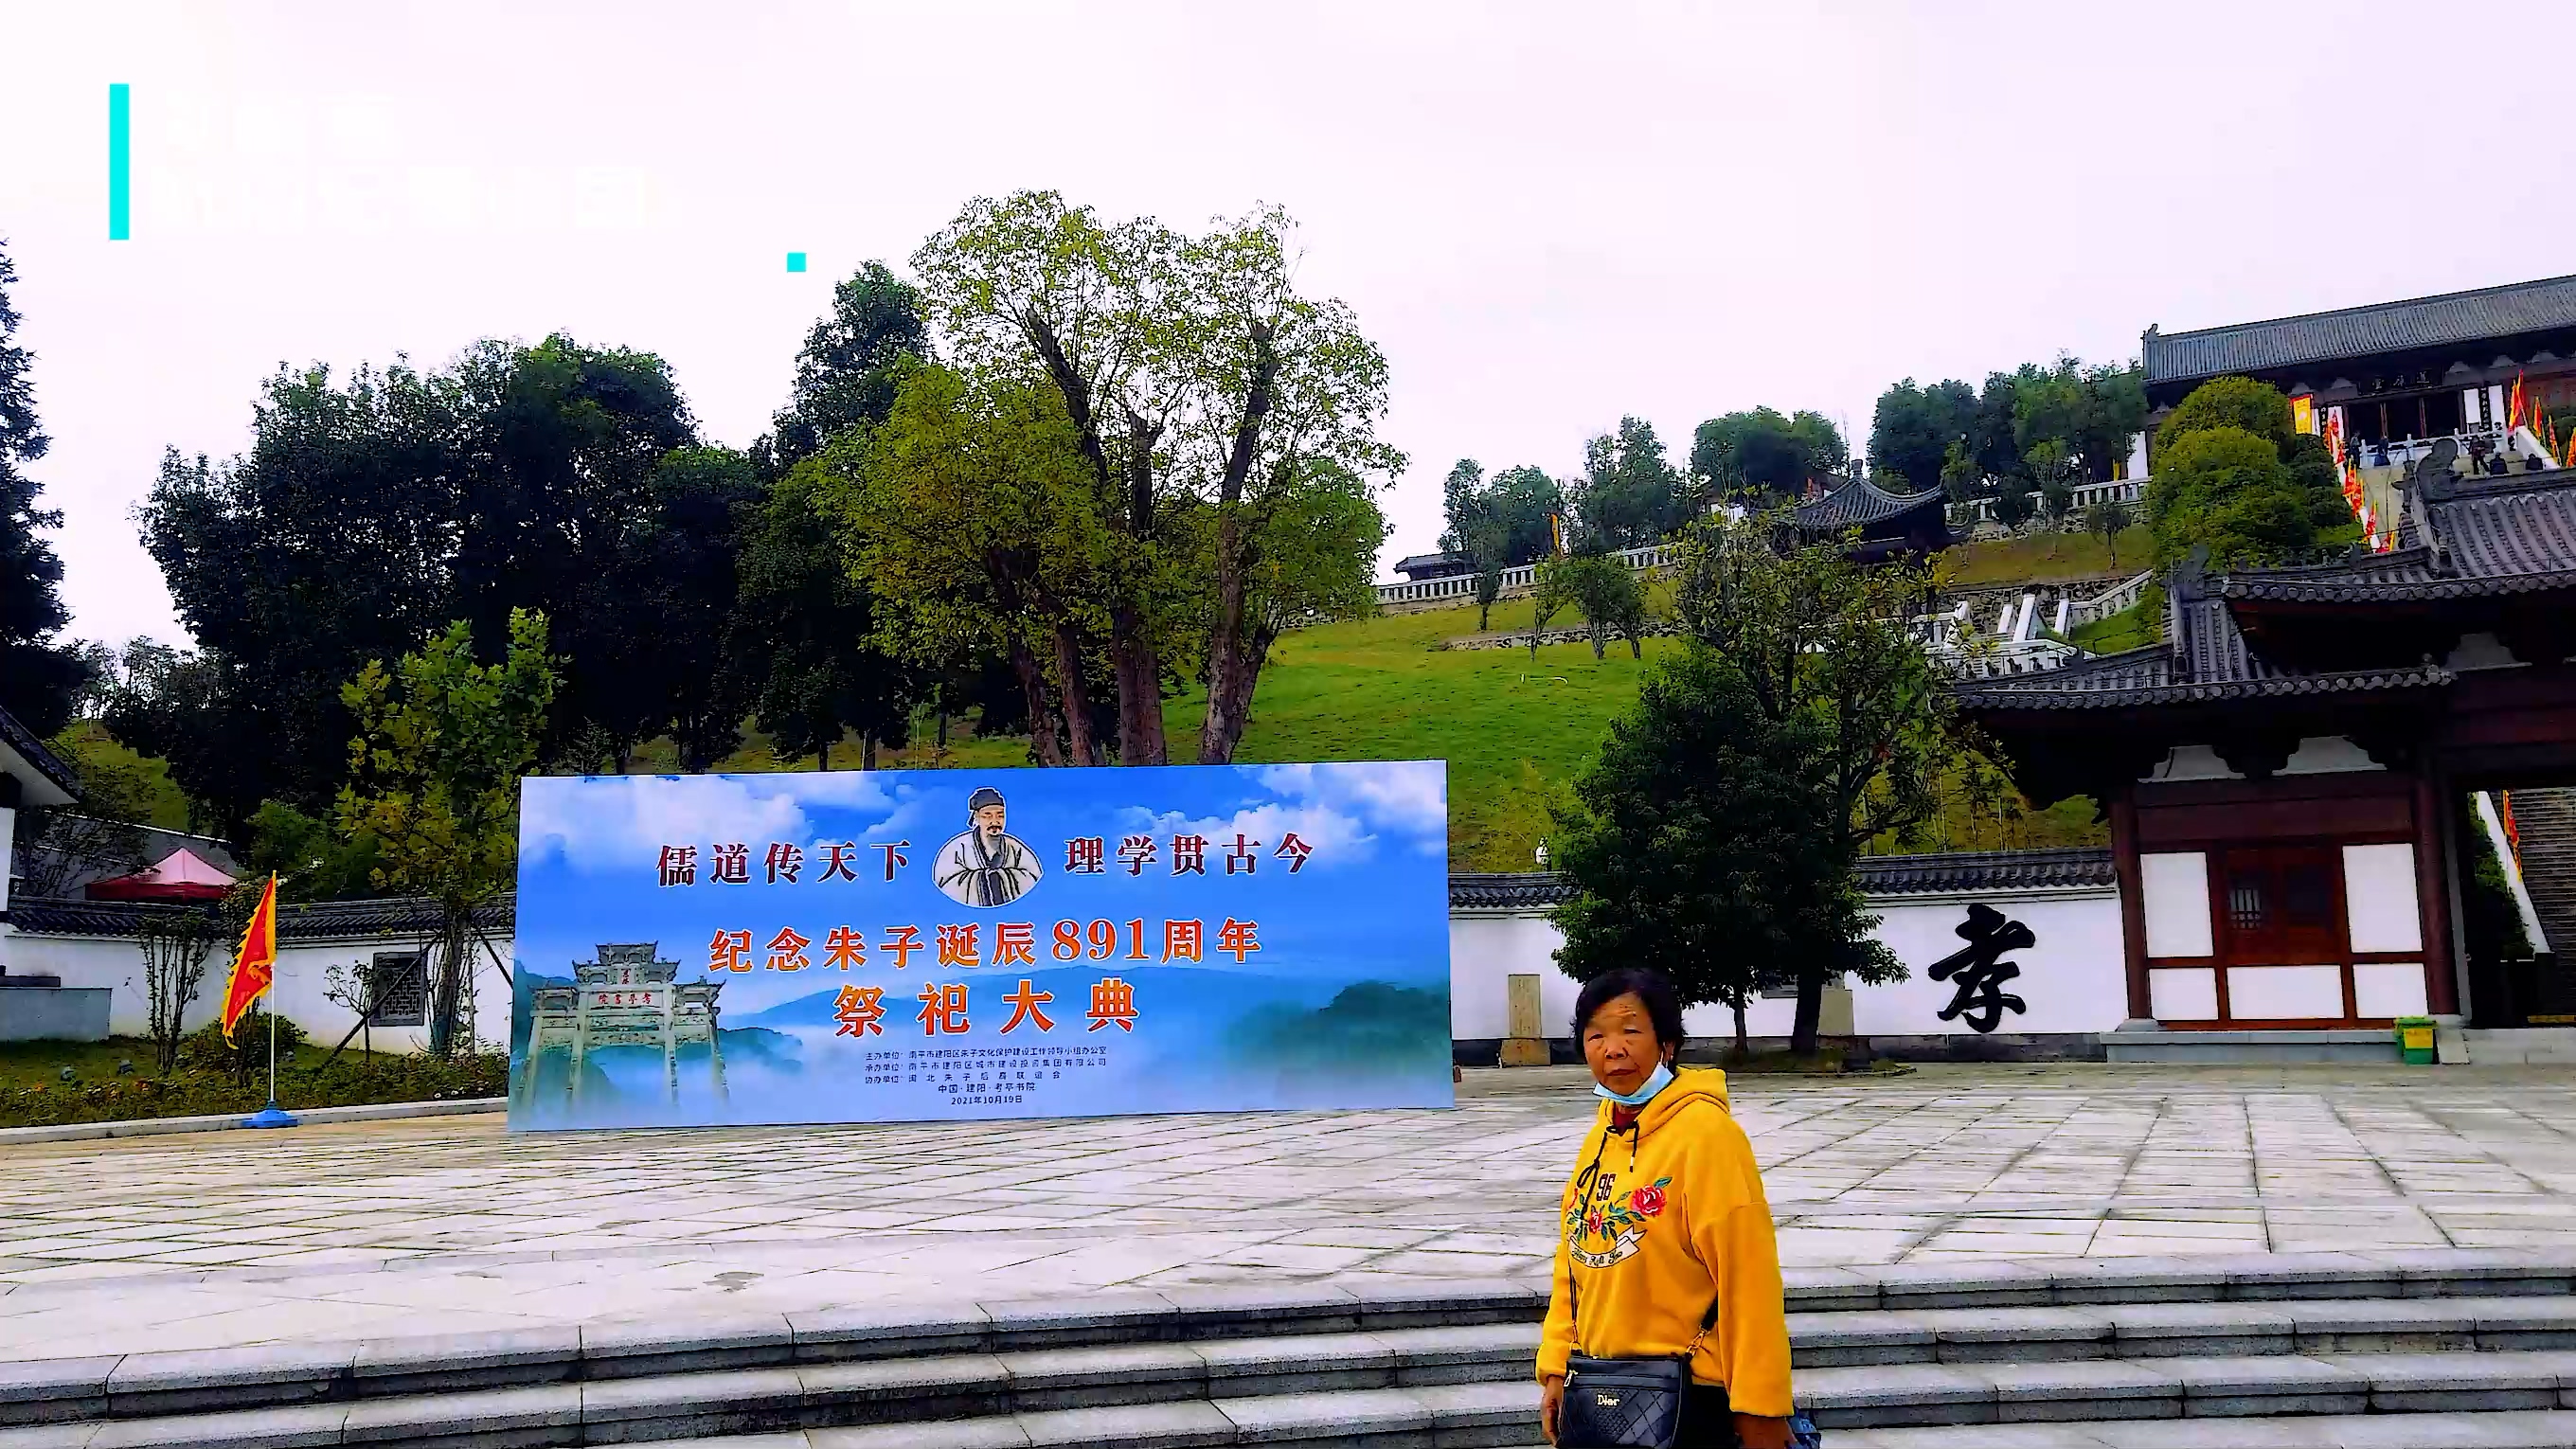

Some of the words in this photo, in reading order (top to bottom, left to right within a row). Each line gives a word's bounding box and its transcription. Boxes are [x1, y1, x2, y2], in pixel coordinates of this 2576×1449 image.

[655, 839, 912, 887] 儒道传天下
[1064, 832, 1315, 877] 理学贯古今
[708, 917, 1261, 974] 纪念朱子诞辰891周年
[1927, 903, 2036, 1033] 孝
[833, 976, 1140, 1038] 祭祀大典
[951, 1095, 1023, 1105] 2021年10月19日
